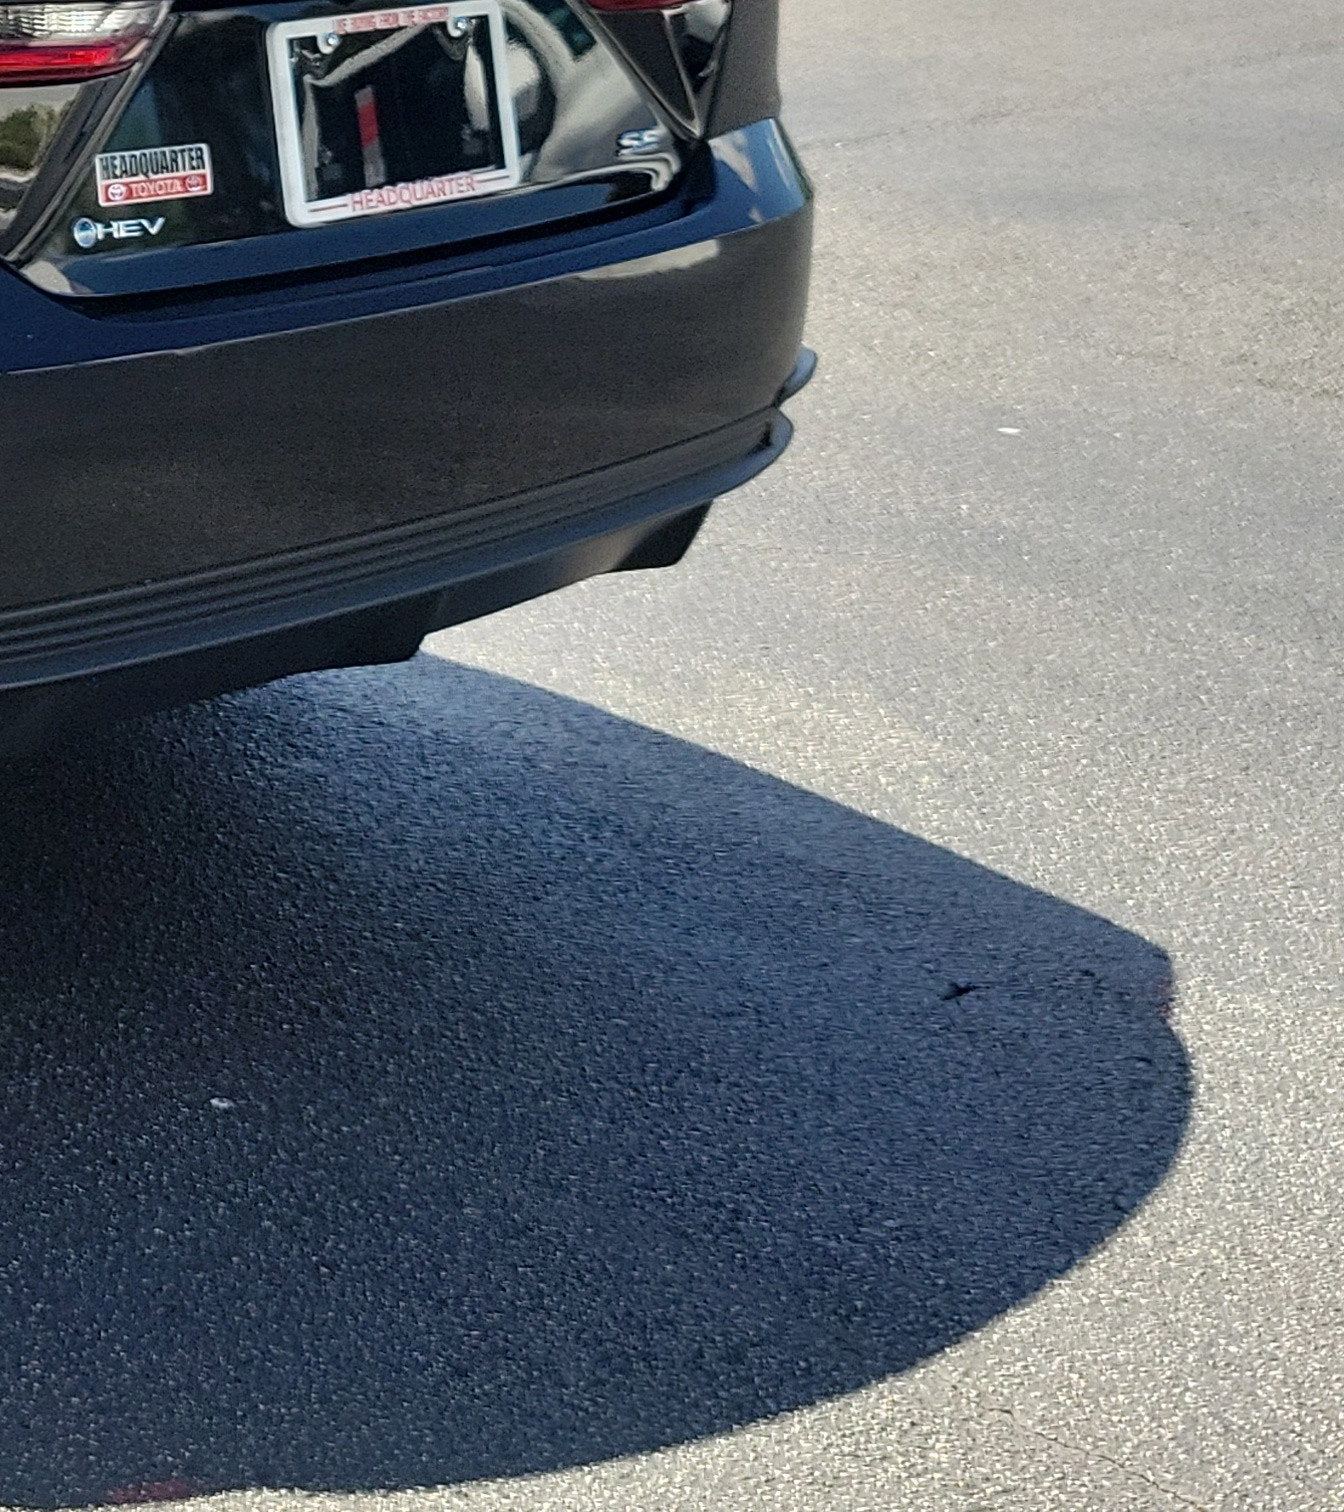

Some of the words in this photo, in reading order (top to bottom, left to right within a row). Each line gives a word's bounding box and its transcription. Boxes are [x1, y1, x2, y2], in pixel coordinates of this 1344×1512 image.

[99, 147, 205, 180] HEADQUARTER
[129, 178, 184, 197] TOYOTA
[350, 174, 476, 211] HEADQUARTER
[95, 216, 166, 240] HEV
